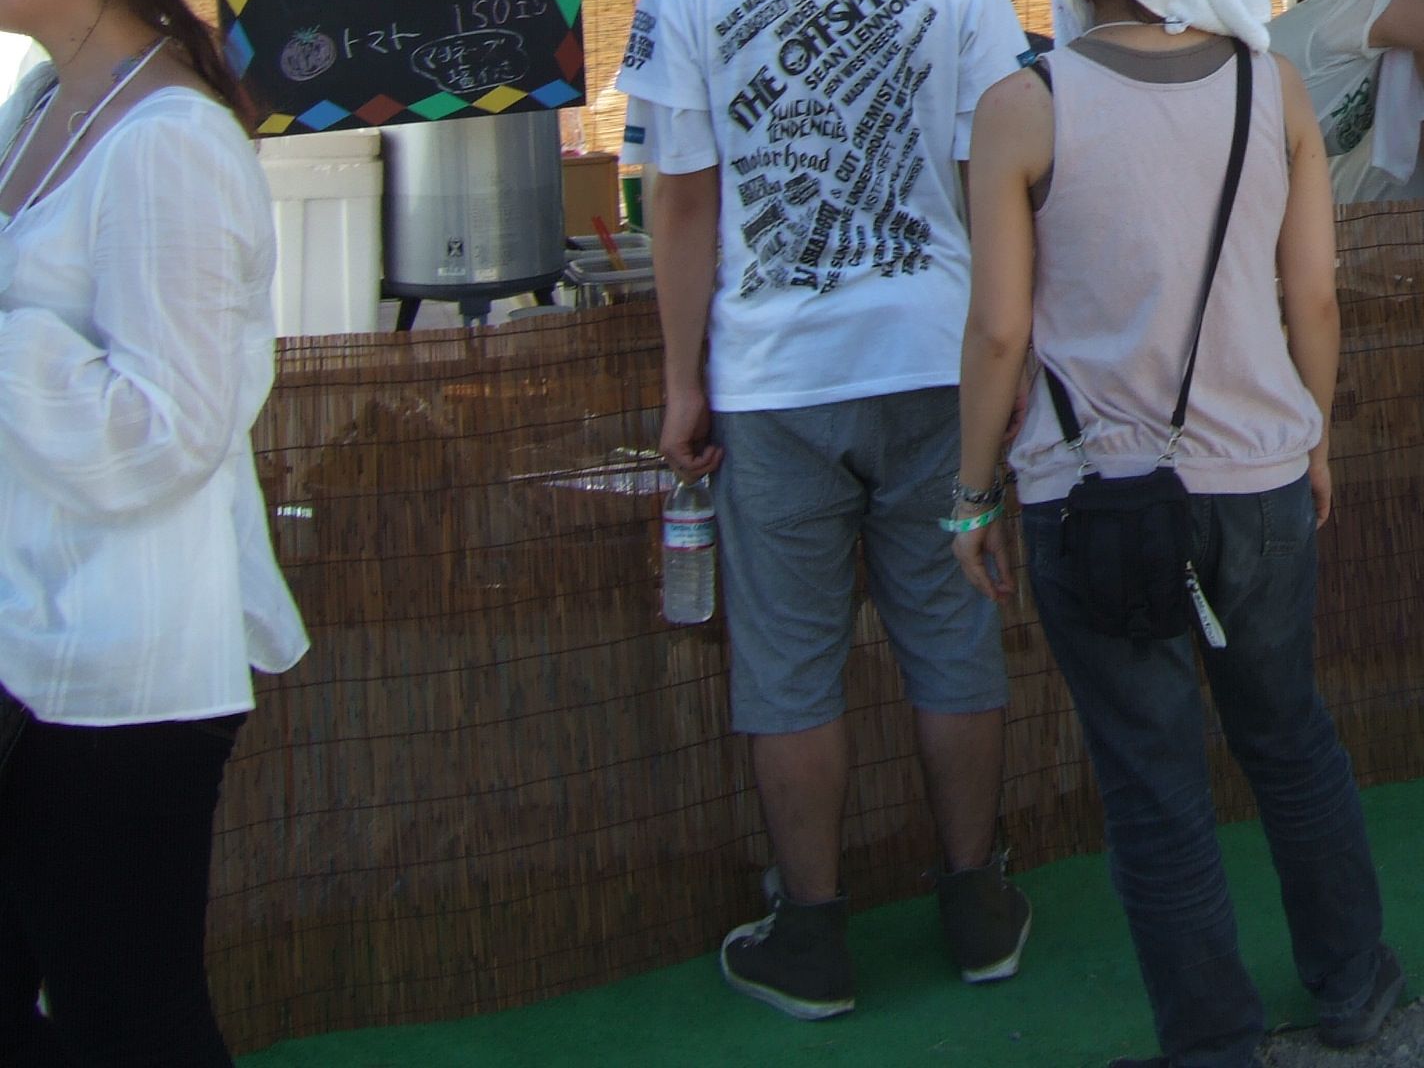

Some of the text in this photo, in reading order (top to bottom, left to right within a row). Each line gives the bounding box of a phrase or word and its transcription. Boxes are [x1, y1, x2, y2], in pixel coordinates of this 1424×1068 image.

[344, 23, 421, 58] トマト
[714, 6, 746, 37] BLUE
[774, 0, 819, 41] HINDER
[804, 46, 849, 91] SEAN
[823, 76, 844, 99] BEN
[728, 64, 788, 132] THE
[834, 149, 861, 183] CUT
[852, 79, 897, 151] CHEMIST
